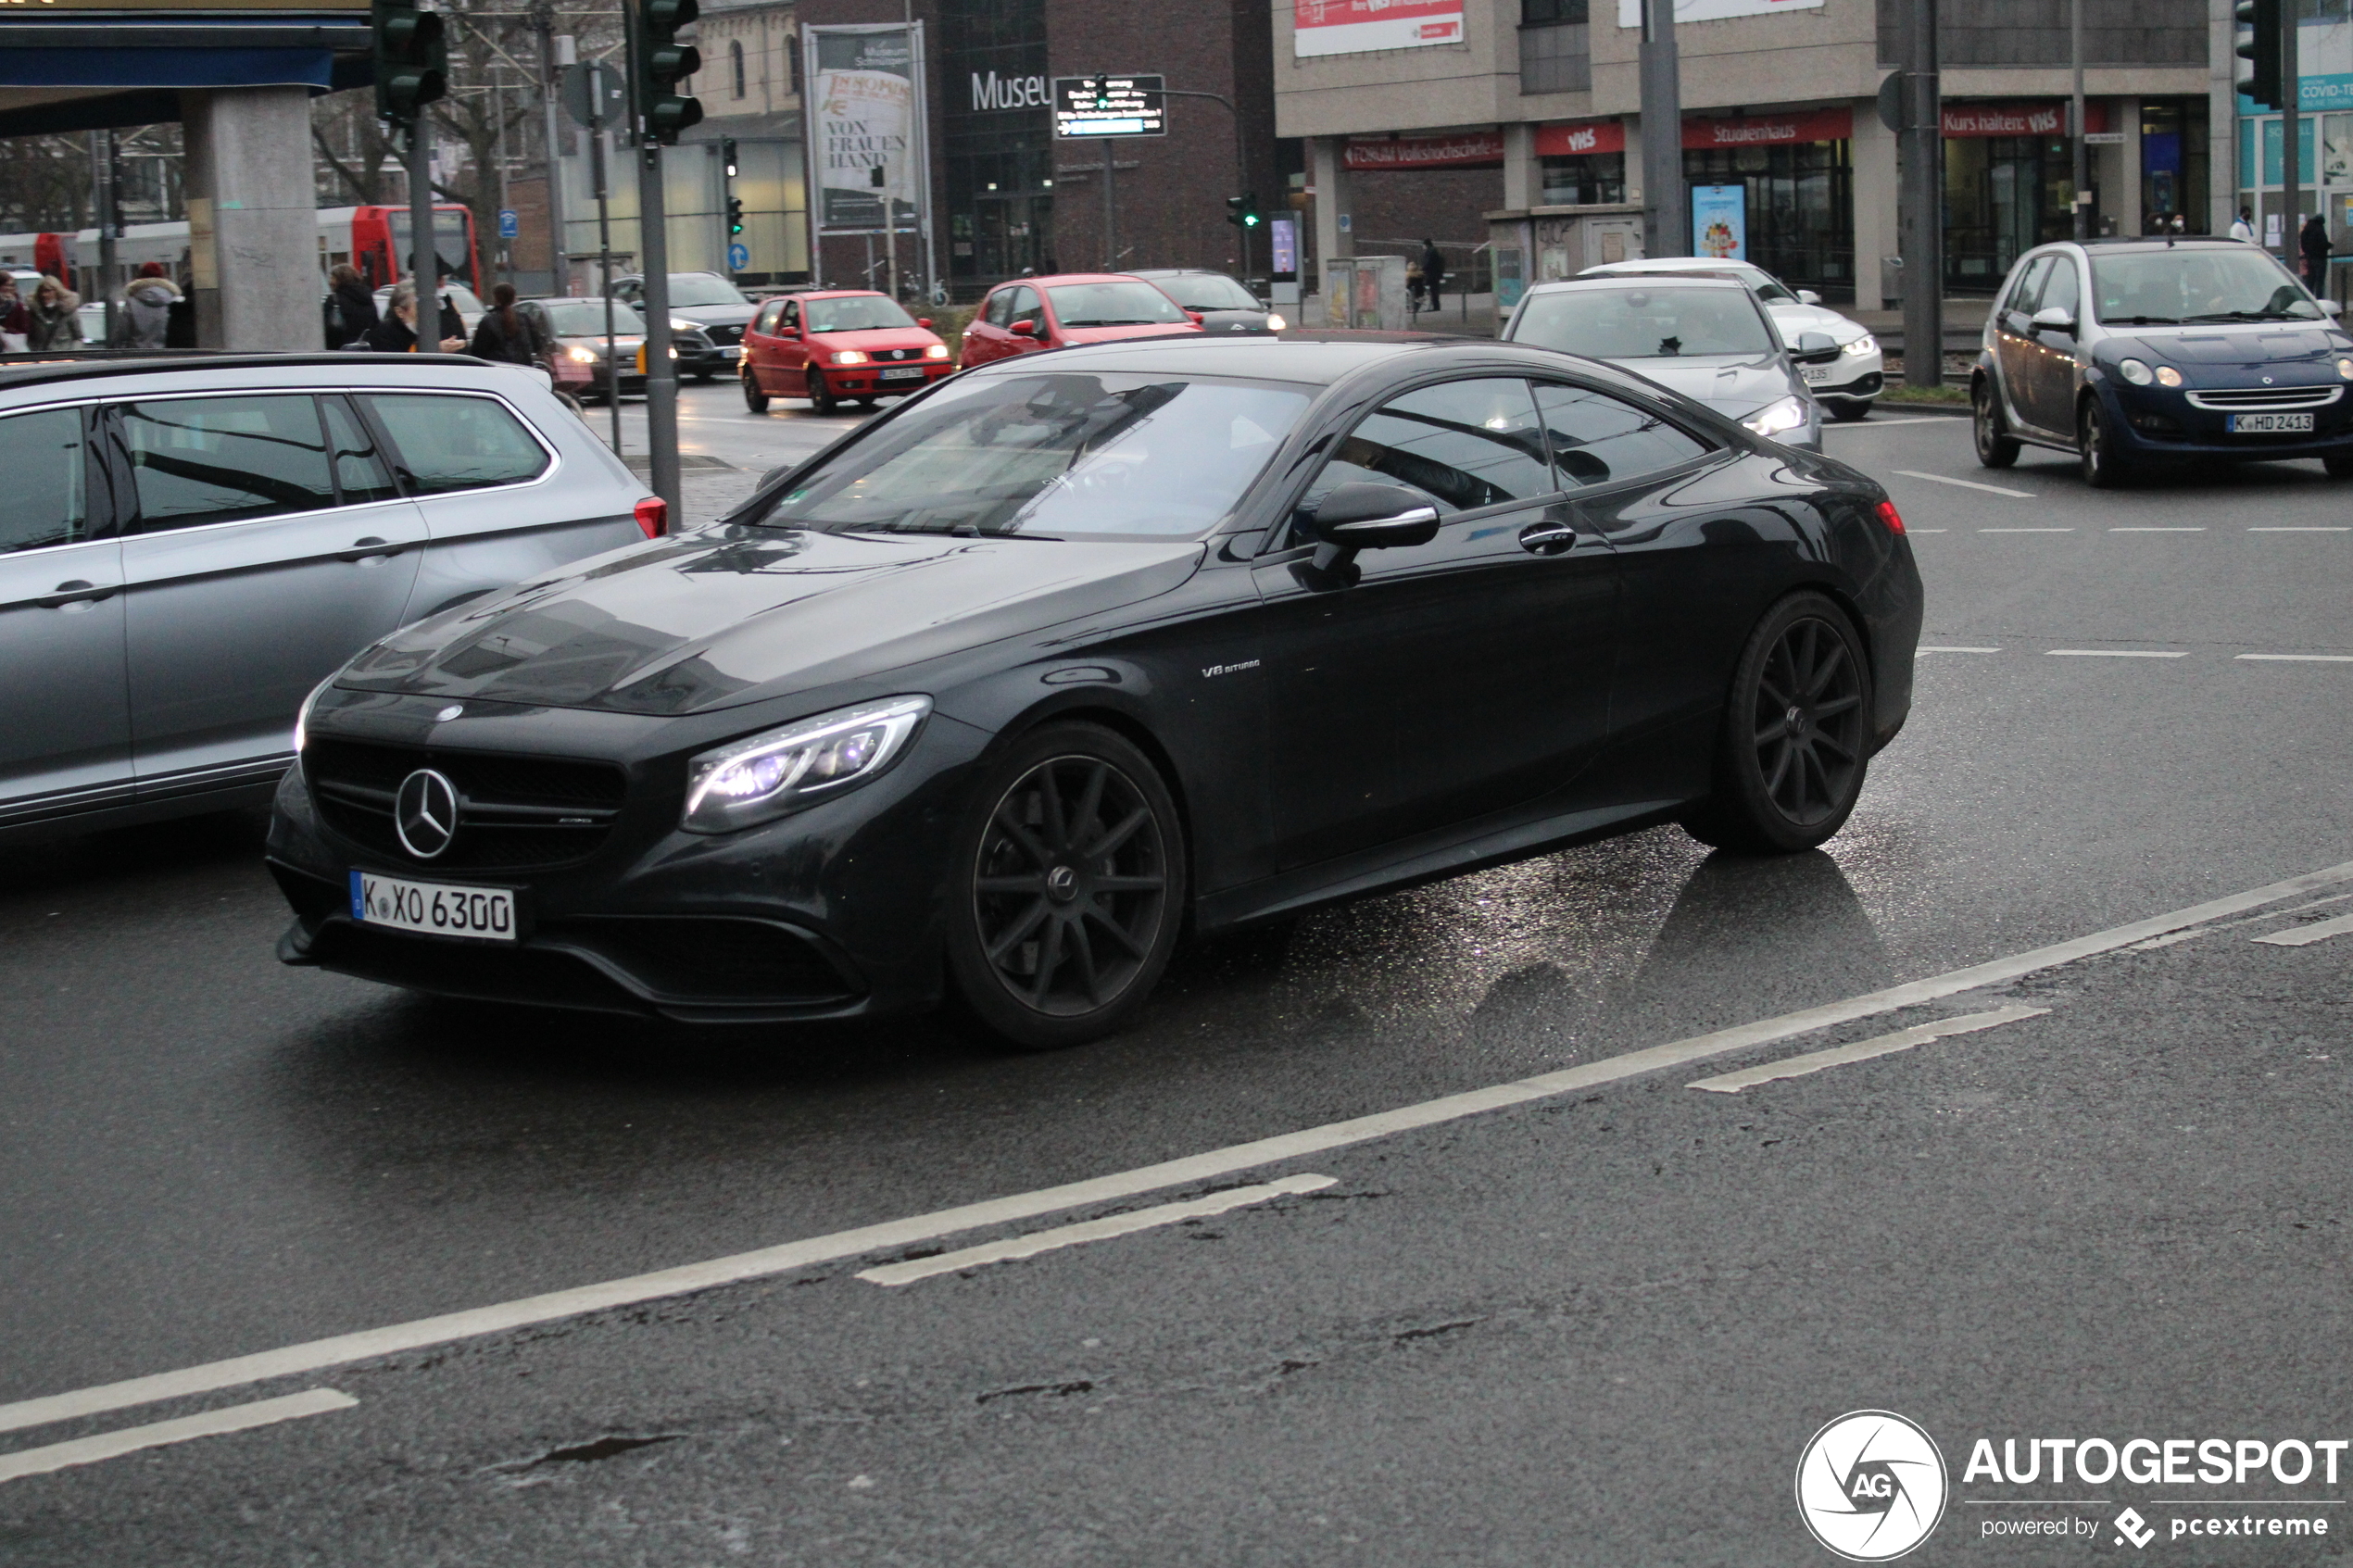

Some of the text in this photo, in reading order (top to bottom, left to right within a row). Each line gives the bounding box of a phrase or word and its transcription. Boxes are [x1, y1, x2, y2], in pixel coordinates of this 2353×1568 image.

[826, 119, 869, 135] VON
[1944, 113, 1976, 131] Kurs
[2028, 109, 2058, 132] VHS
[827, 135, 907, 151] FRAUEN
[1567, 128, 1597, 151] VHS
[1714, 124, 1796, 143] Studienhaus
[829, 152, 888, 169] HAND
[1353, 145, 1396, 162] FORUM
[1397, 141, 1492, 162] Volkshochschule
[2234, 415, 2312, 430] K HD 2413
[1202, 659, 1261, 678] V8 BITURBO
[363, 879, 510, 933] K XO 6300
